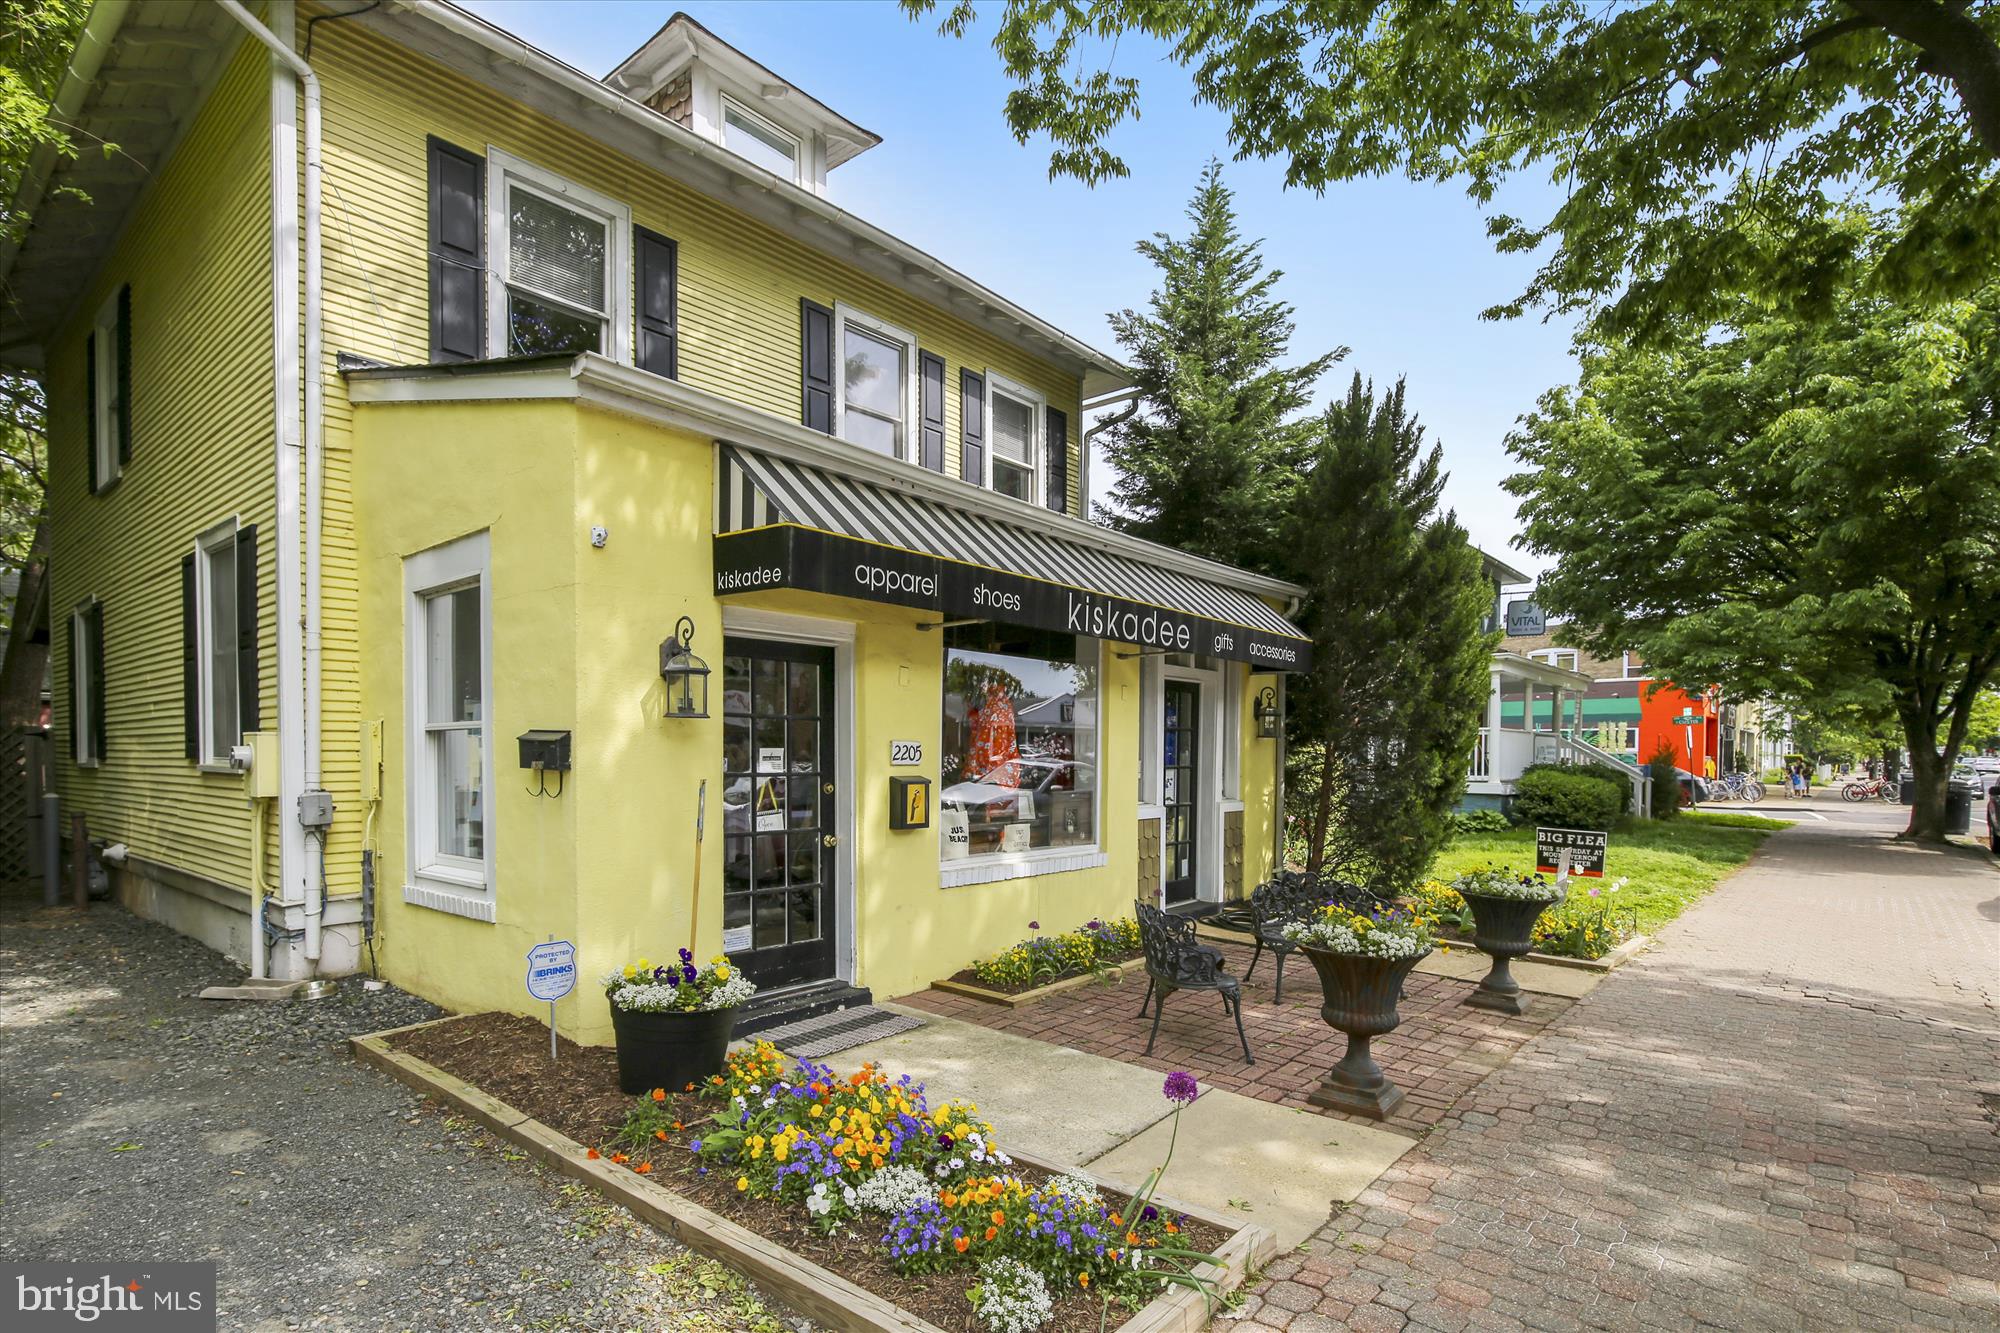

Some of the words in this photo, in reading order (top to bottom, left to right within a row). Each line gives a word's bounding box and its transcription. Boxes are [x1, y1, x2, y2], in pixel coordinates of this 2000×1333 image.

[717, 566, 782, 590] kiskadee
[855, 564, 938, 597] apparel
[973, 583, 1021, 612] shoes
[1067, 592, 1191, 650] kiskadee
[1214, 632, 1234, 652] gifts
[1249, 641, 1296, 663] accessories
[1511, 616, 1541, 626] VITAL
[892, 744, 922, 762] 2205
[1538, 832, 1563, 843] BIG
[1567, 834, 1605, 846] FLEA
[1555, 846, 1592, 855] SARDAY
[534, 949, 570, 959] PROTECTED
[538, 964, 573, 977] BRINKS
